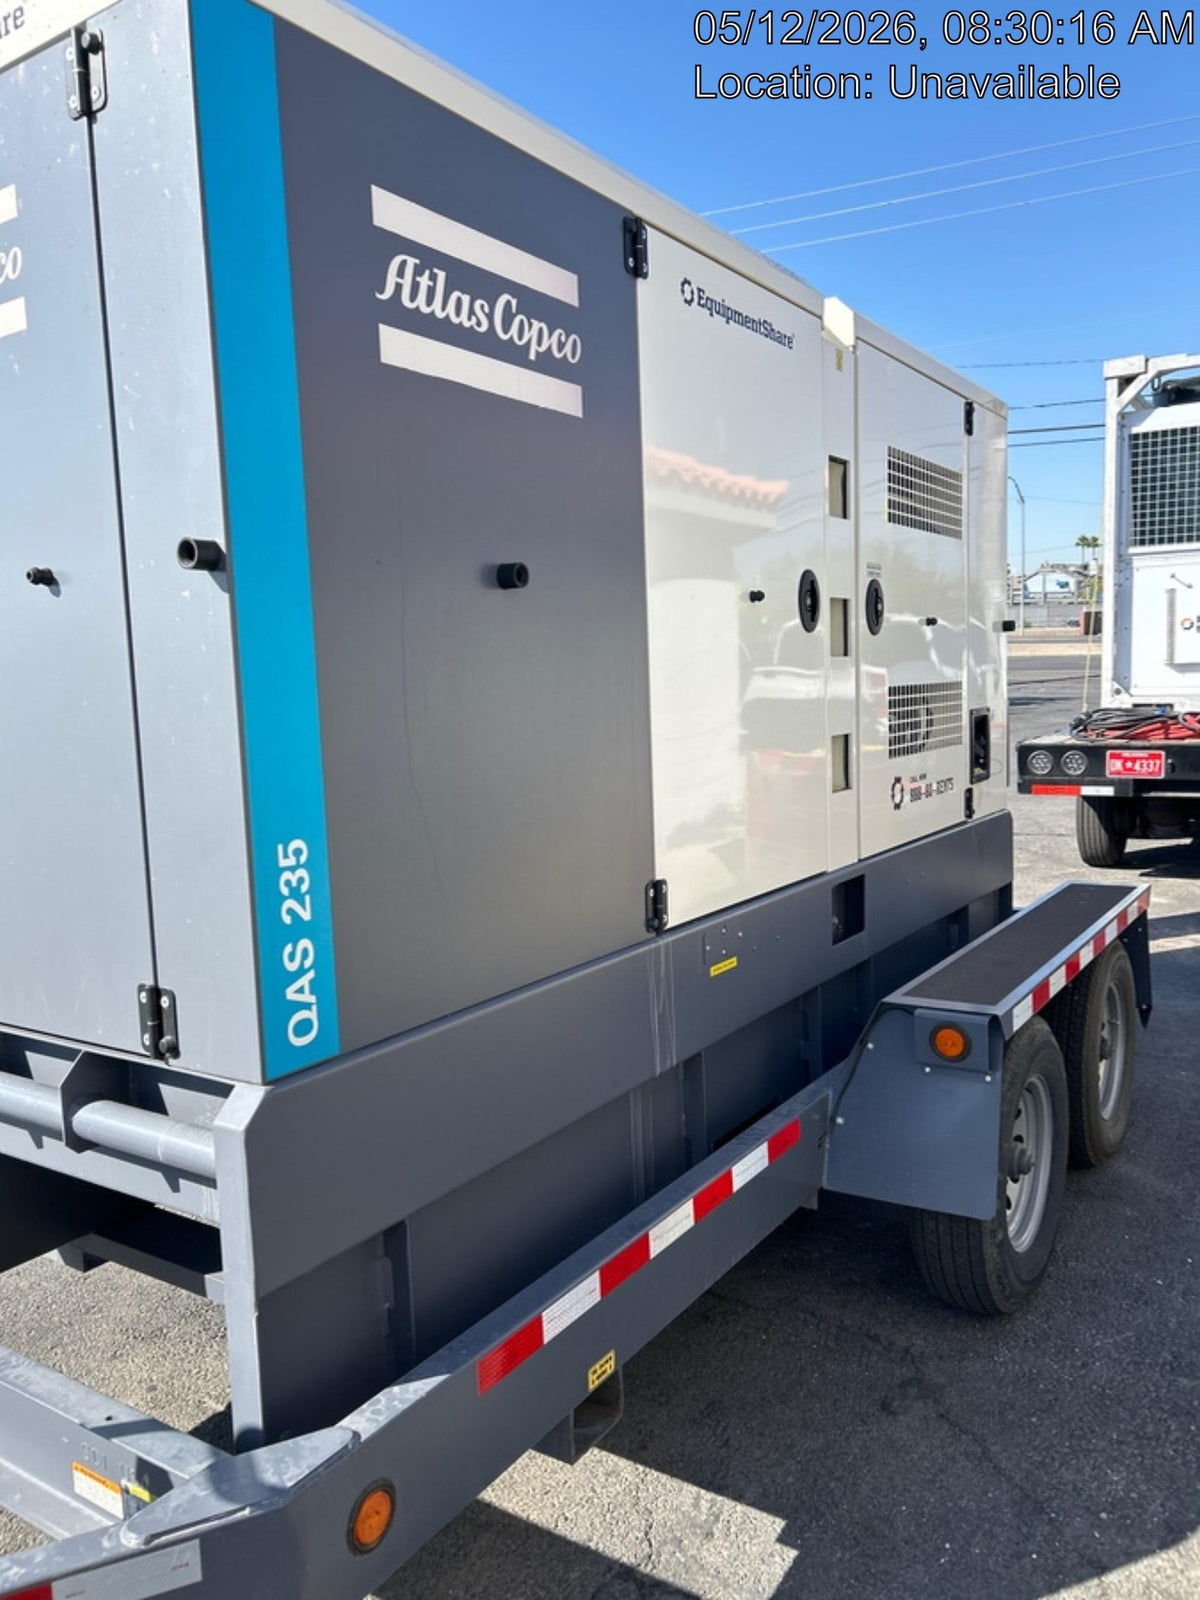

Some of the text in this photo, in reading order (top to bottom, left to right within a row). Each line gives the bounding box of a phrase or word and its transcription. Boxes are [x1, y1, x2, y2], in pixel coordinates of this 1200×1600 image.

[375, 254, 582, 363] Atlas Copco
[277, 838, 319, 1047] QAS 235
